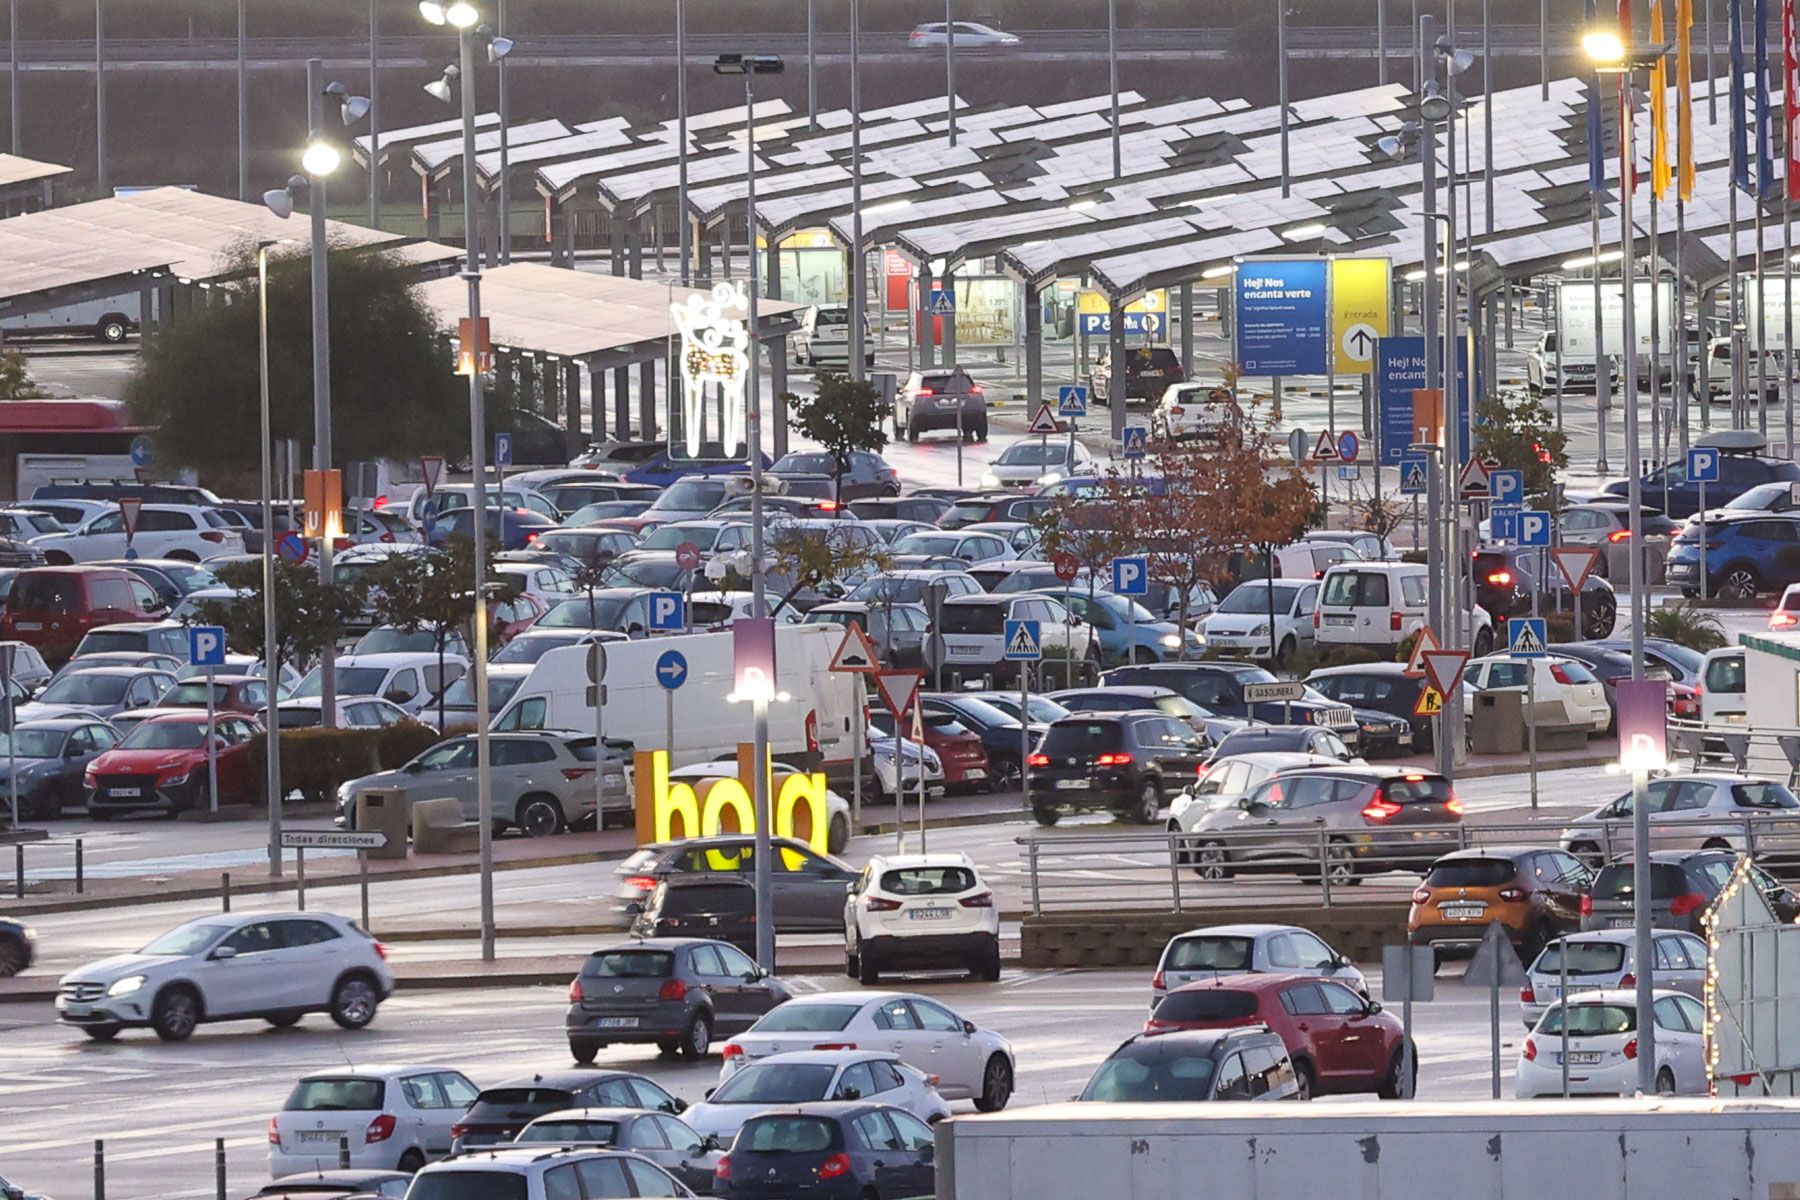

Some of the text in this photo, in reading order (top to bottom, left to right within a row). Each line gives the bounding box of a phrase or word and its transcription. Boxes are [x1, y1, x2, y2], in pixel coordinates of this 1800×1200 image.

[1244, 278, 1284, 289] Hej! Nos
[1244, 289, 1311, 299] encanta verte
[1344, 310, 1378, 319] Entrada
[1412, 358, 1426, 367] No
[1388, 371, 1426, 380] encant
[499, 439, 508, 461] P
[1694, 454, 1711, 477] P
[1496, 475, 1516, 500] P
[1524, 517, 1542, 541] P
[1120, 564, 1139, 589] P
[656, 598, 676, 624] P
[197, 633, 217, 661] P
[285, 834, 375, 844] Todas direcciones
